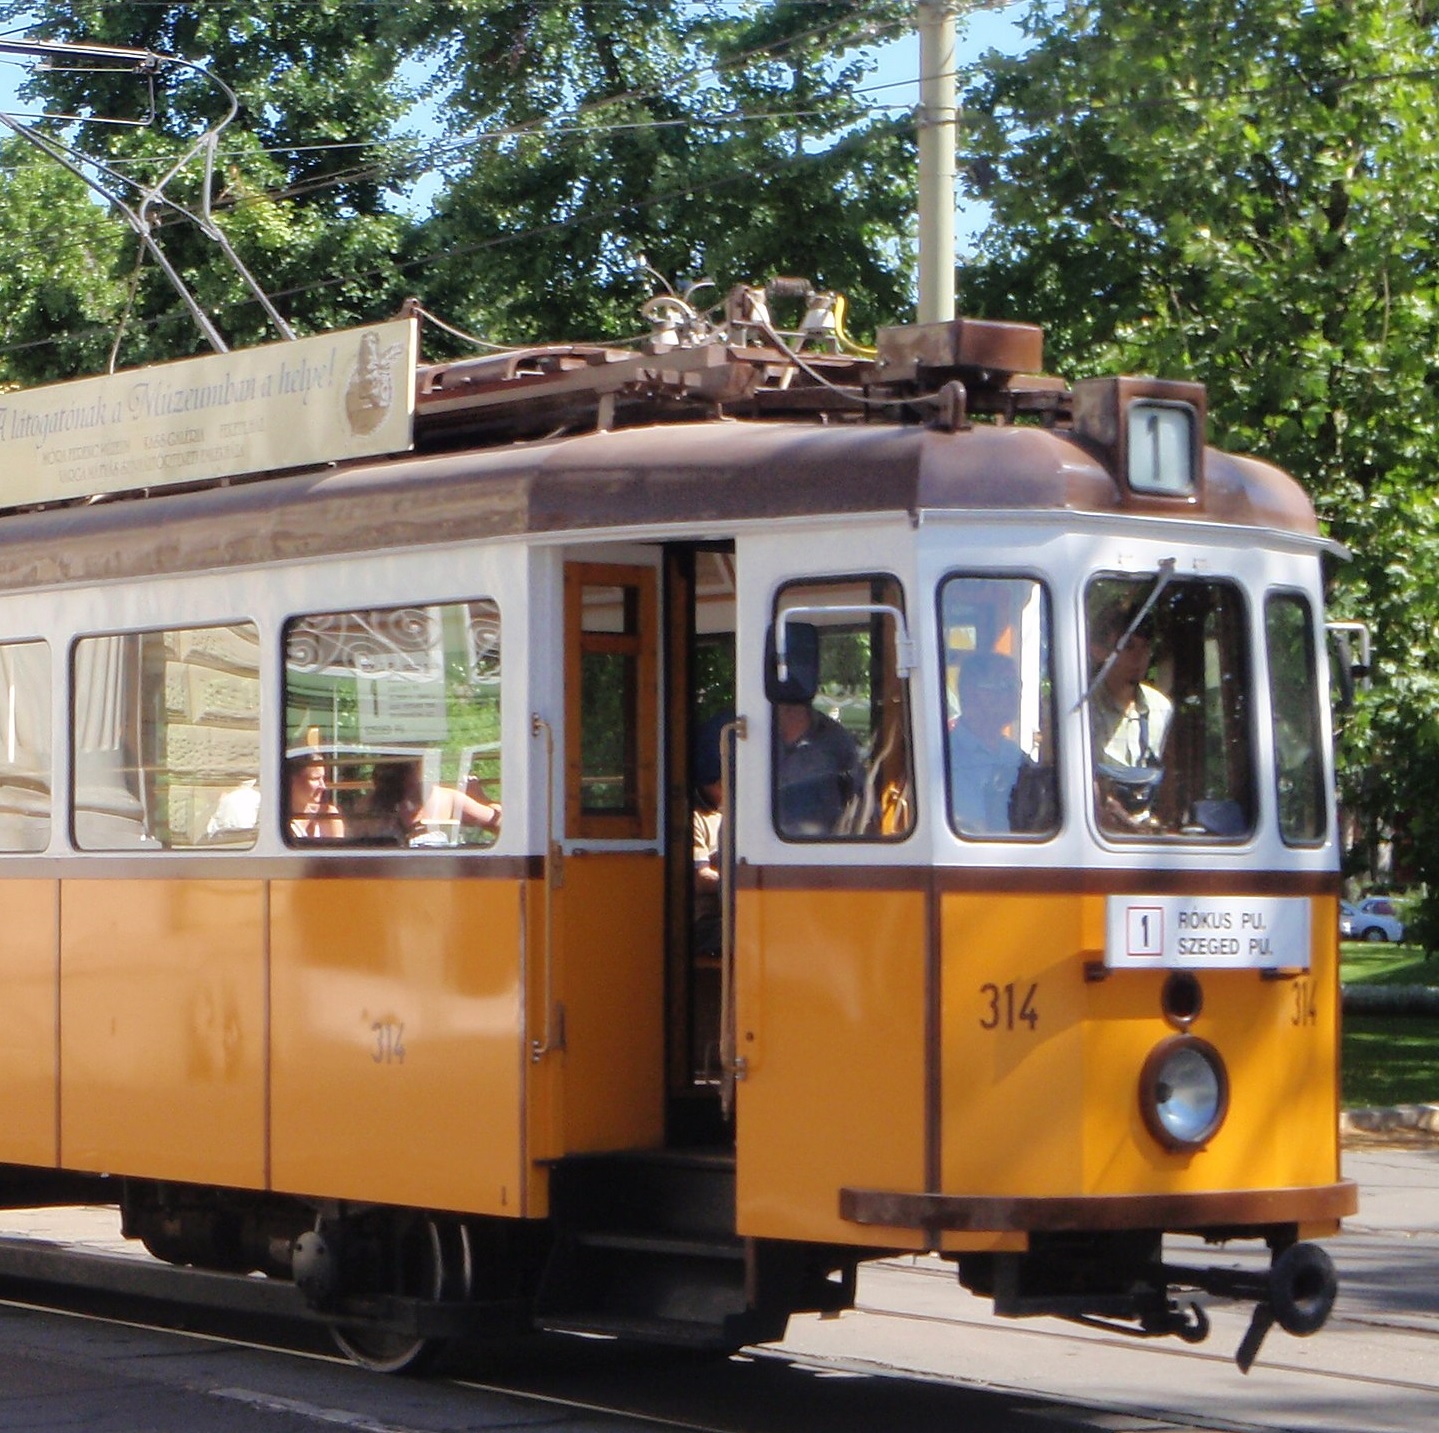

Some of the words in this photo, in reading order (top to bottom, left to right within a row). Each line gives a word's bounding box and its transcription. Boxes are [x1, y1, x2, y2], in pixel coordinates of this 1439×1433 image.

[10, 396, 105, 449] látogatónak
[112, 402, 122, 423] a
[128, 372, 256, 420] Múzeumban
[261, 374, 272, 398] a
[1146, 413, 1160, 482] 1
[1141, 915, 1149, 947] 1
[1178, 905, 1232, 929] RÓKUS
[1242, 912, 1266, 929] PU.
[1178, 937, 1239, 955] SZEGED
[1249, 938, 1273, 955] PU.
[980, 983, 1038, 1031] 314
[1292, 981, 1317, 1026] 314
[371, 1021, 406, 1065] 314
